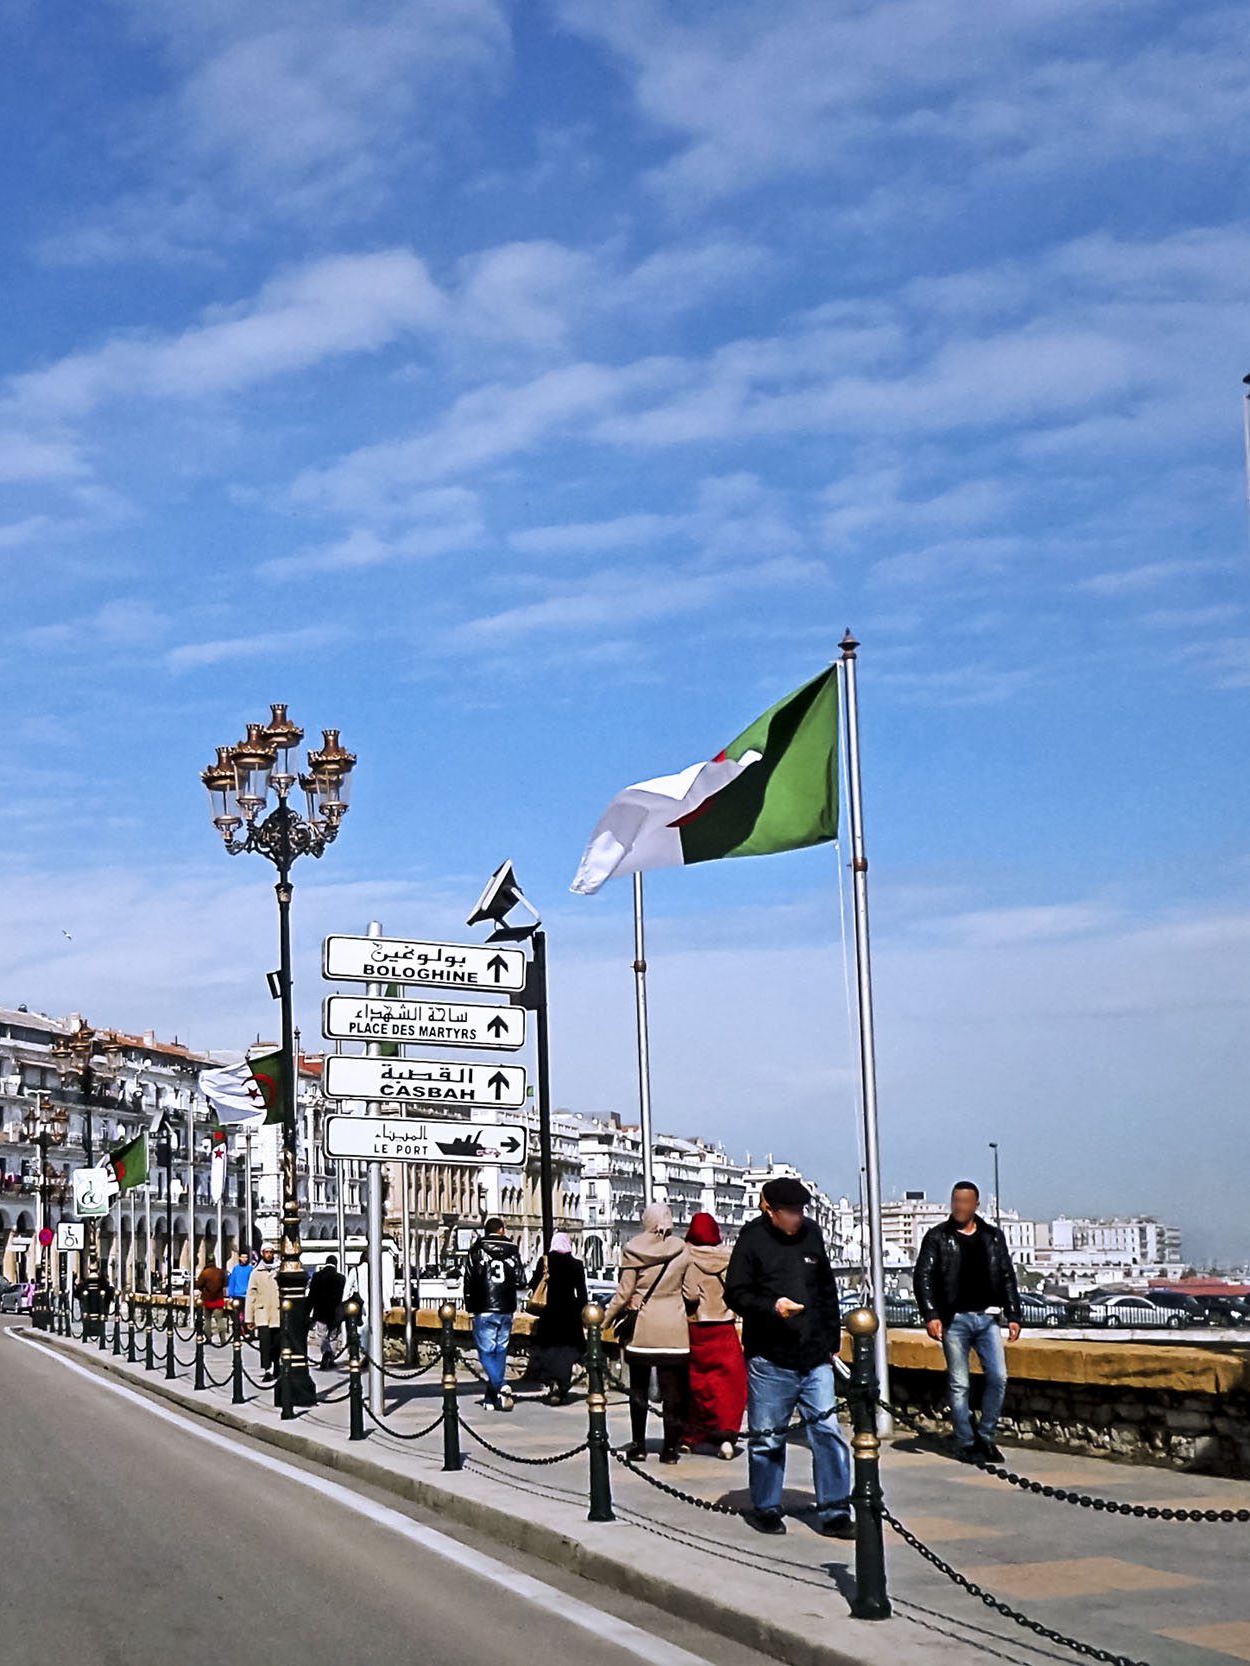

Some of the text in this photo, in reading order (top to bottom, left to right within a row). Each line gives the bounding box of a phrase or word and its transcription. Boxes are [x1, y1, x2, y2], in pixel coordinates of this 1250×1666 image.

[371, 942, 466, 968] بولوغين
[363, 964, 479, 983] BOLOGHINE
[355, 1004, 468, 1022] ساحة الشهداء
[349, 1022, 477, 1040] PLACE DES MARTYRS
[381, 1064, 473, 1084] القصبة
[380, 1084, 475, 1100] CASBAH
[375, 1124, 428, 1142] الميناء
[374, 1144, 428, 1155] LE PORT
[491, 1260, 506, 1284] 3
